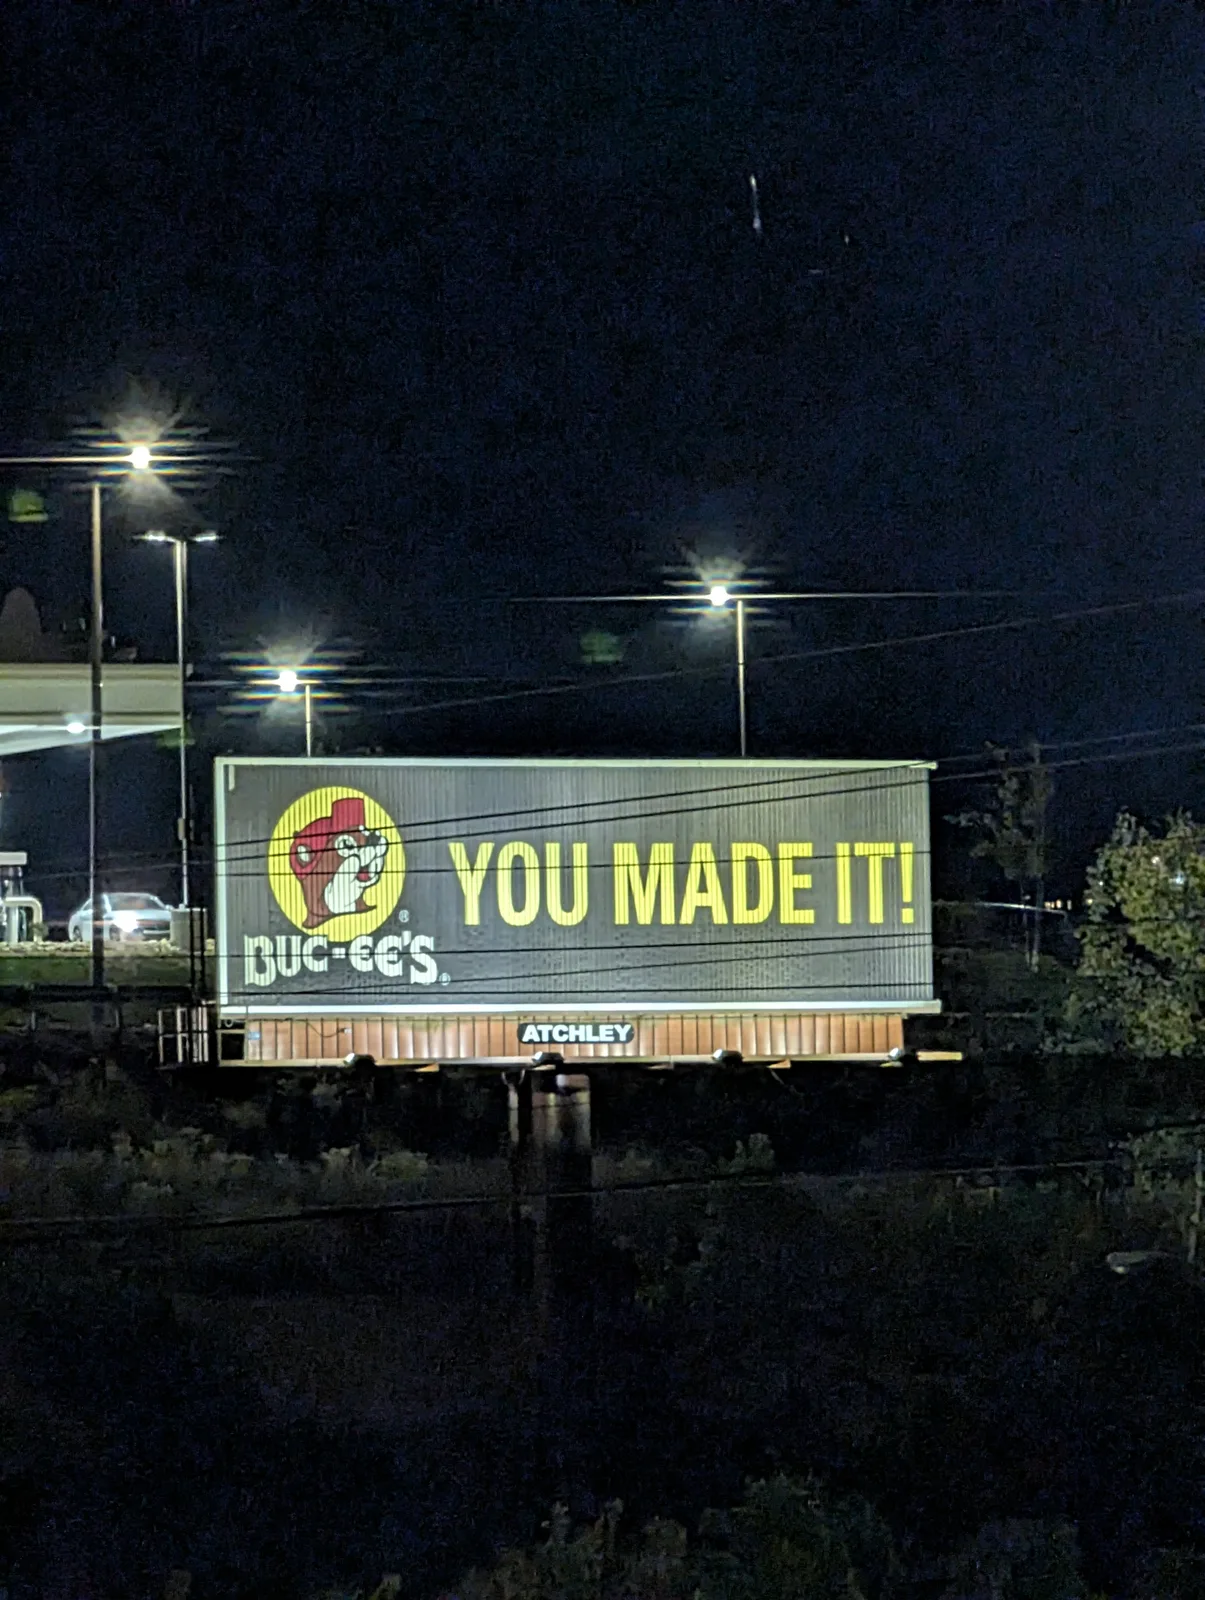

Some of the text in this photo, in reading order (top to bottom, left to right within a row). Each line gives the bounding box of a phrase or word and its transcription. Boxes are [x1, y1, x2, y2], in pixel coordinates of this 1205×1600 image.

[449, 841, 914, 926] YOU MADE IT!
[521, 1024, 631, 1042] ATCHLEY
